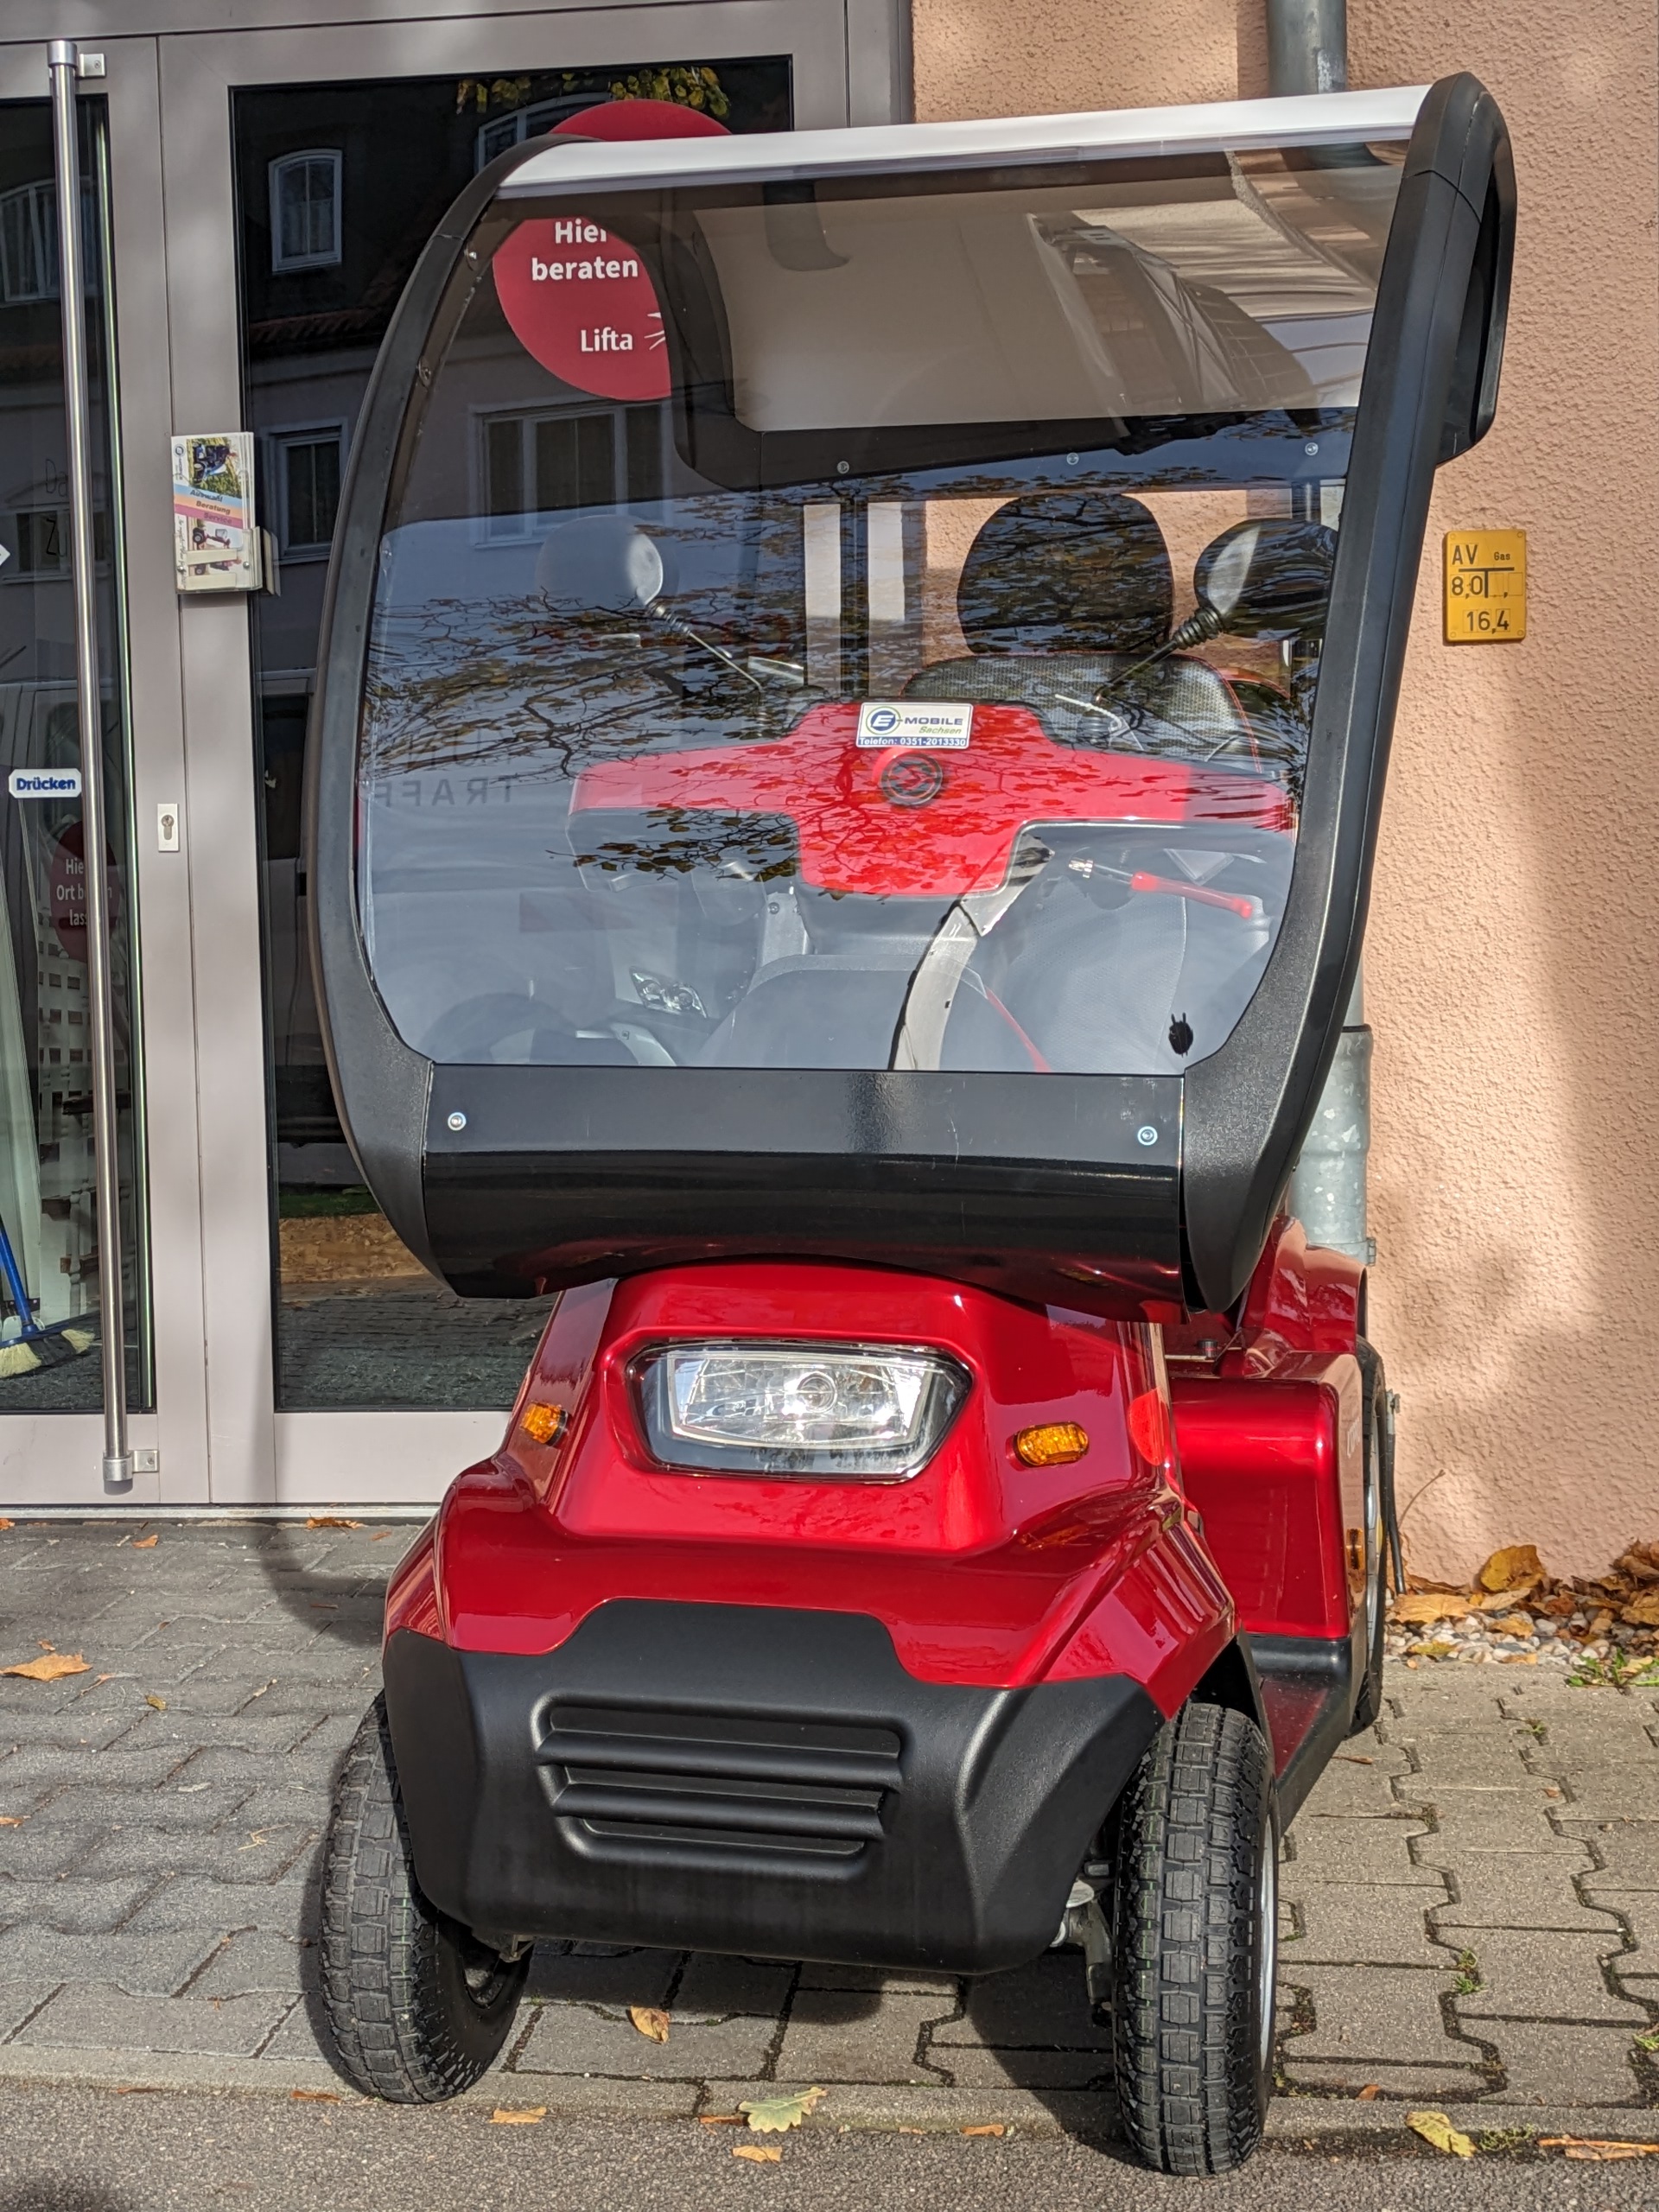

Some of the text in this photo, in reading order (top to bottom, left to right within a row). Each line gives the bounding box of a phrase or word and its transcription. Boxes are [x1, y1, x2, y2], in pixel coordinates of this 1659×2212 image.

[531, 256, 639, 281] beraten
[581, 327, 633, 352] Lifta
[196, 500, 231, 515] Beratung
[1452, 543, 1510, 565] AV Gas
[1466, 610, 1510, 634] 16,4
[918, 726, 962, 734] Sachsen
[860, 737, 967, 747] Telefon: 0351-2013330
[16, 777, 76, 791] Drücken
[56, 884, 75, 900] Ort
